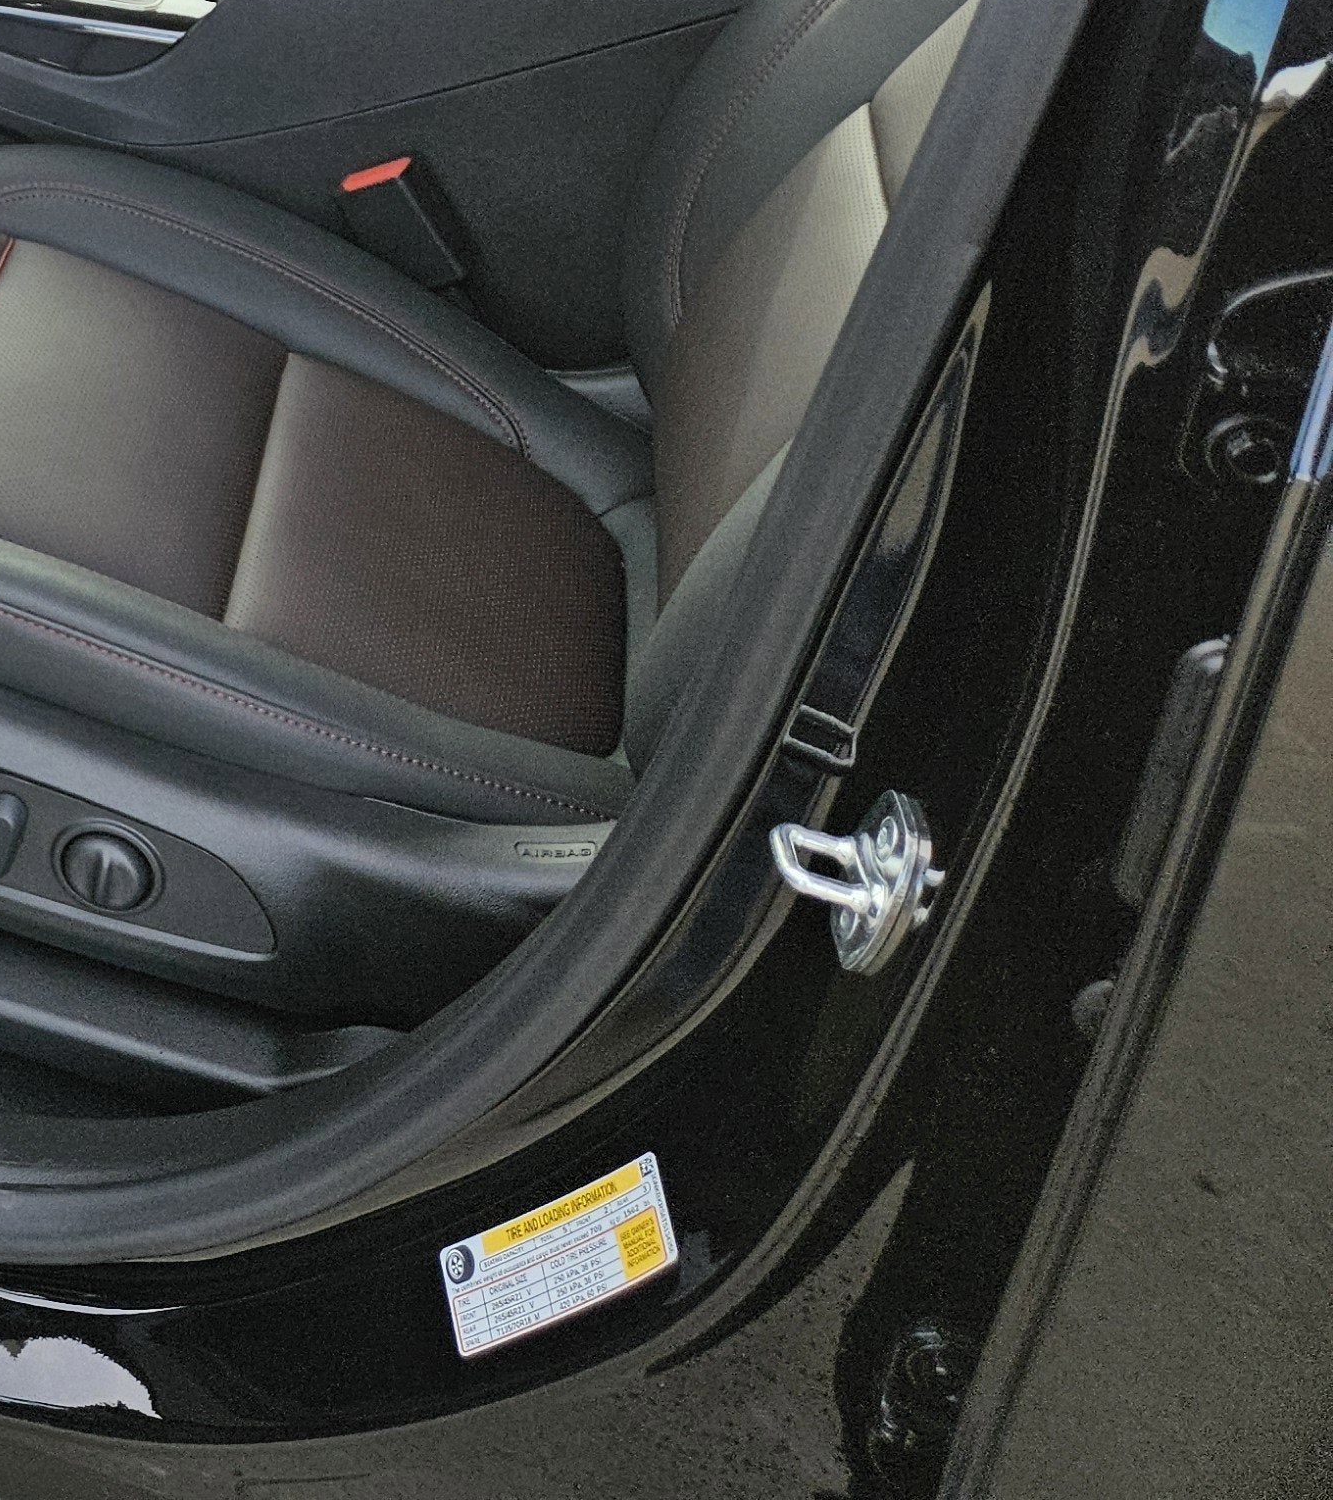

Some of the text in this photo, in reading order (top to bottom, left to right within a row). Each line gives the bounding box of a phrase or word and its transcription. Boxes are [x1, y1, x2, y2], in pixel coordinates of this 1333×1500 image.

[522, 848, 593, 858] AIRBAG
[505, 1178, 618, 1243] TIRE AND LOADING INFORMATION
[549, 1255, 565, 1270] COLD
[577, 1236, 607, 1257] PRESSURE
[590, 1256, 601, 1267] PSI
[593, 1268, 604, 1280] PSI
